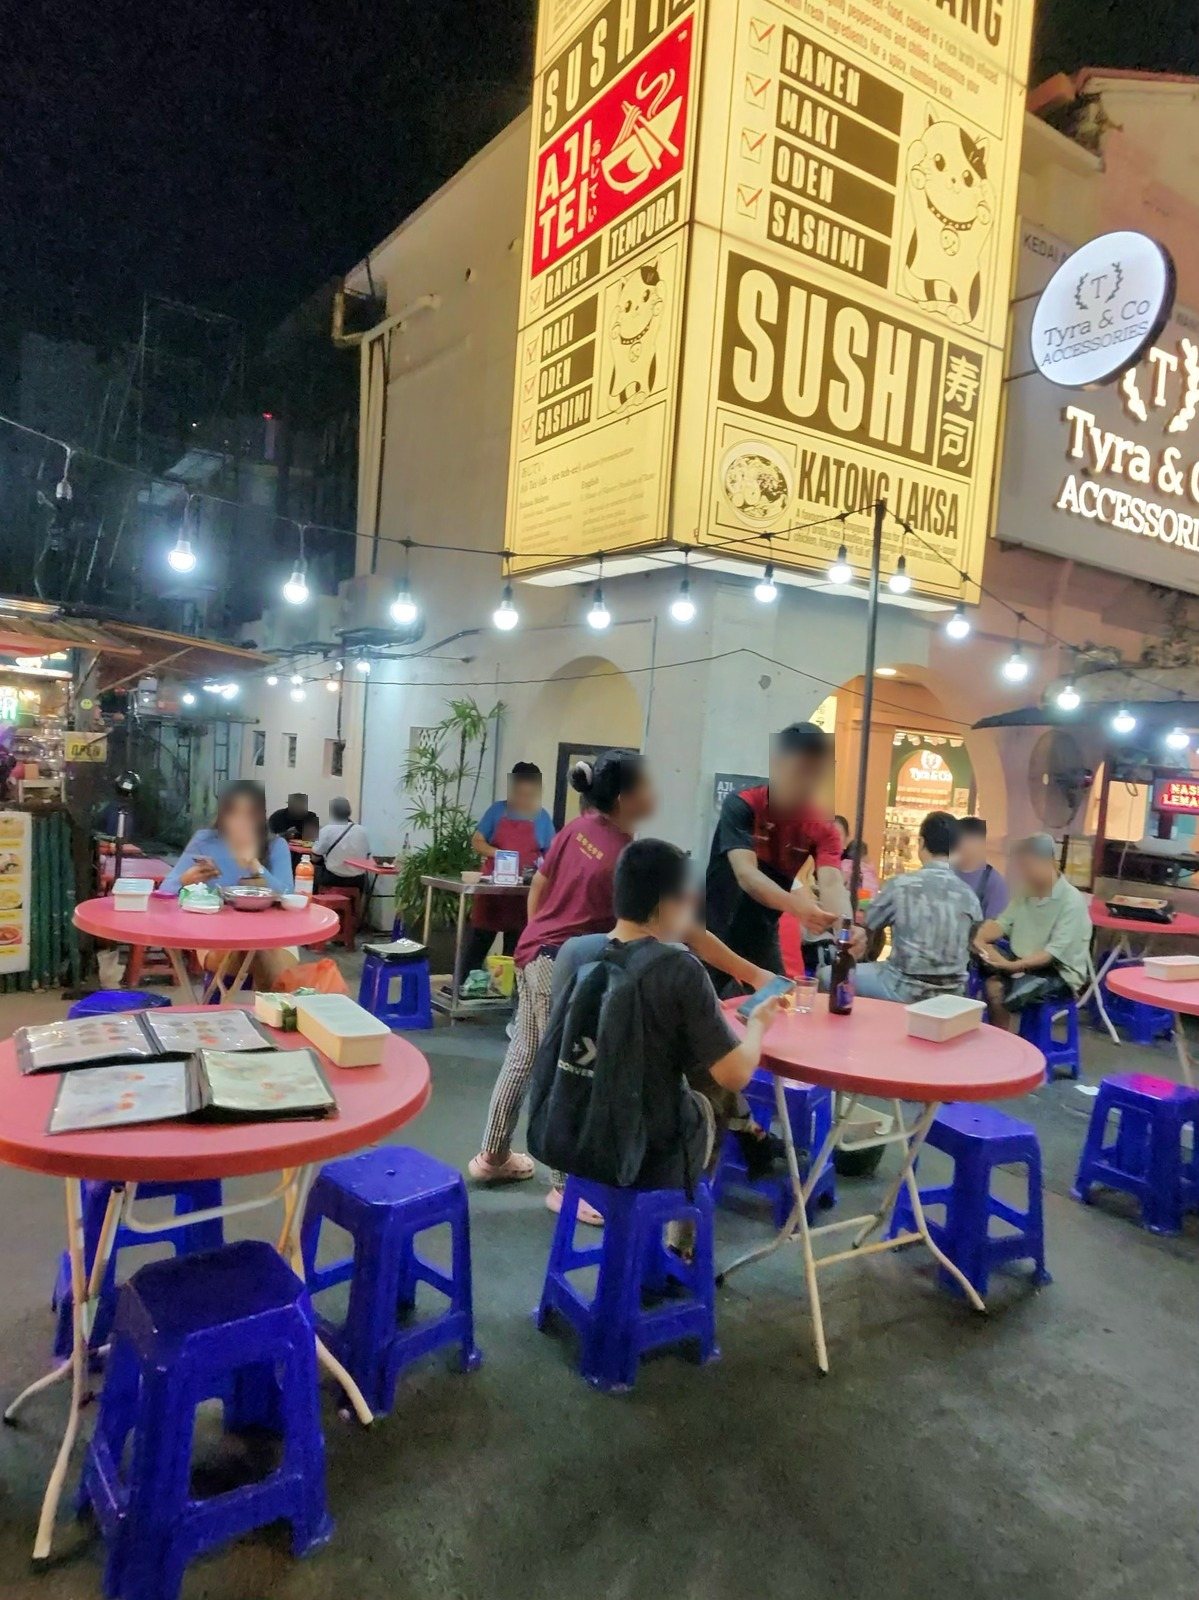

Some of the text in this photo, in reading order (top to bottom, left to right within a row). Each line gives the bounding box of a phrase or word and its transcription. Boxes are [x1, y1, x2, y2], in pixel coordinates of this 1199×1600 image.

[784, 33, 861, 107] RAMEN
[781, 88, 839, 150] MAKI
[538, 119, 593, 212] AJI
[775, 145, 834, 204] ODEN
[538, 178, 589, 261] TEI
[609, 189, 676, 261] TEMPURA
[771, 200, 866, 273] SASHIMI
[546, 249, 588, 303] RAMEN
[543, 312, 575, 360] MAKI
[1041, 321, 1149, 367] ACCESSORIES
[1044, 300, 1150, 347] Tyra & Co
[539, 357, 571, 399] ODEN
[732, 269, 936, 455] SUSHI
[1150, 346, 1178, 407] T
[536, 389, 590, 441] SASHIMI
[941, 355, 980, 468] 寿司
[1066, 405, 1150, 484] Tyra
[1158, 446, 1184, 496] &
[799, 447, 890, 518] KATONG
[895, 477, 959, 540] LAKSA
